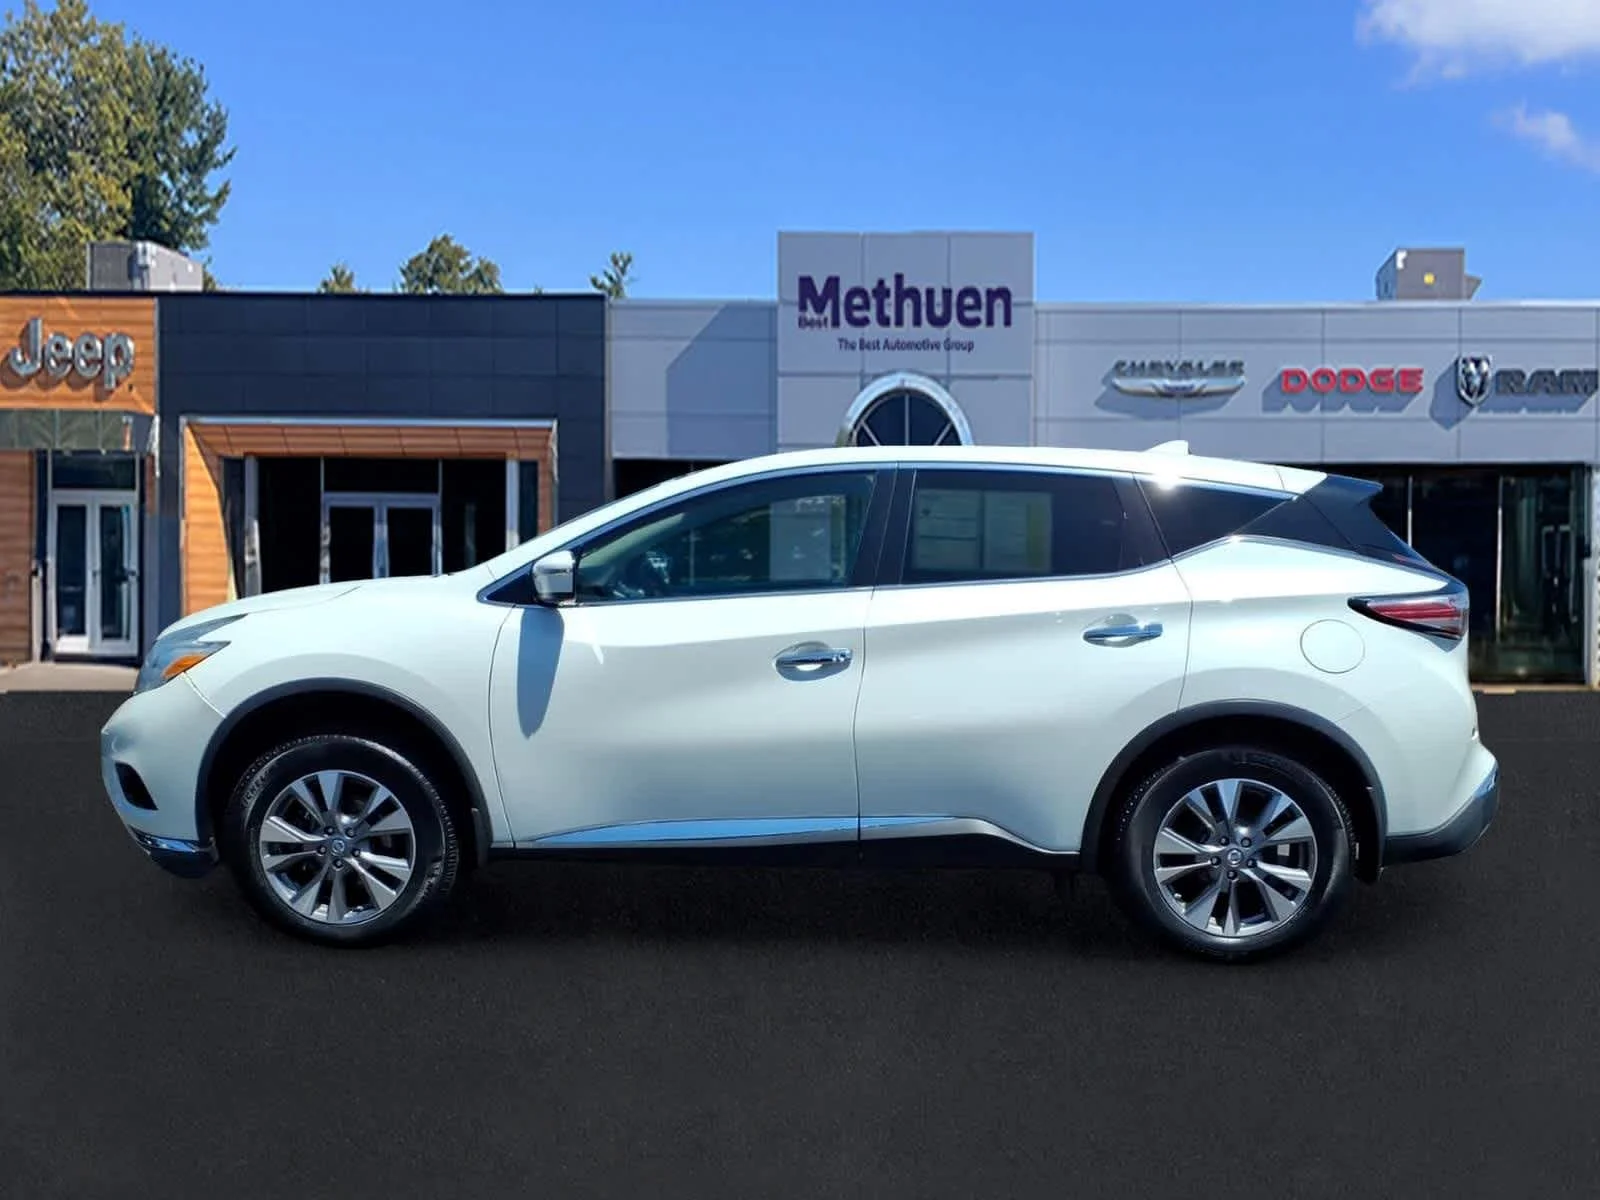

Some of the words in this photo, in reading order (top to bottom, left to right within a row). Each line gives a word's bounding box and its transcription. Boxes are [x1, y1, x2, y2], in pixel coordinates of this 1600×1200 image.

[798, 272, 1012, 328] Methuen
[8, 317, 135, 391] Jeep
[838, 338, 857, 351] The
[859, 338, 880, 351] Best
[883, 338, 941, 351] Automotive
[944, 338, 975, 353] Group
[1113, 360, 1245, 376] CHRYSLER
[1281, 367, 1424, 394] DODGE
[1495, 369, 1599, 394] RAM
